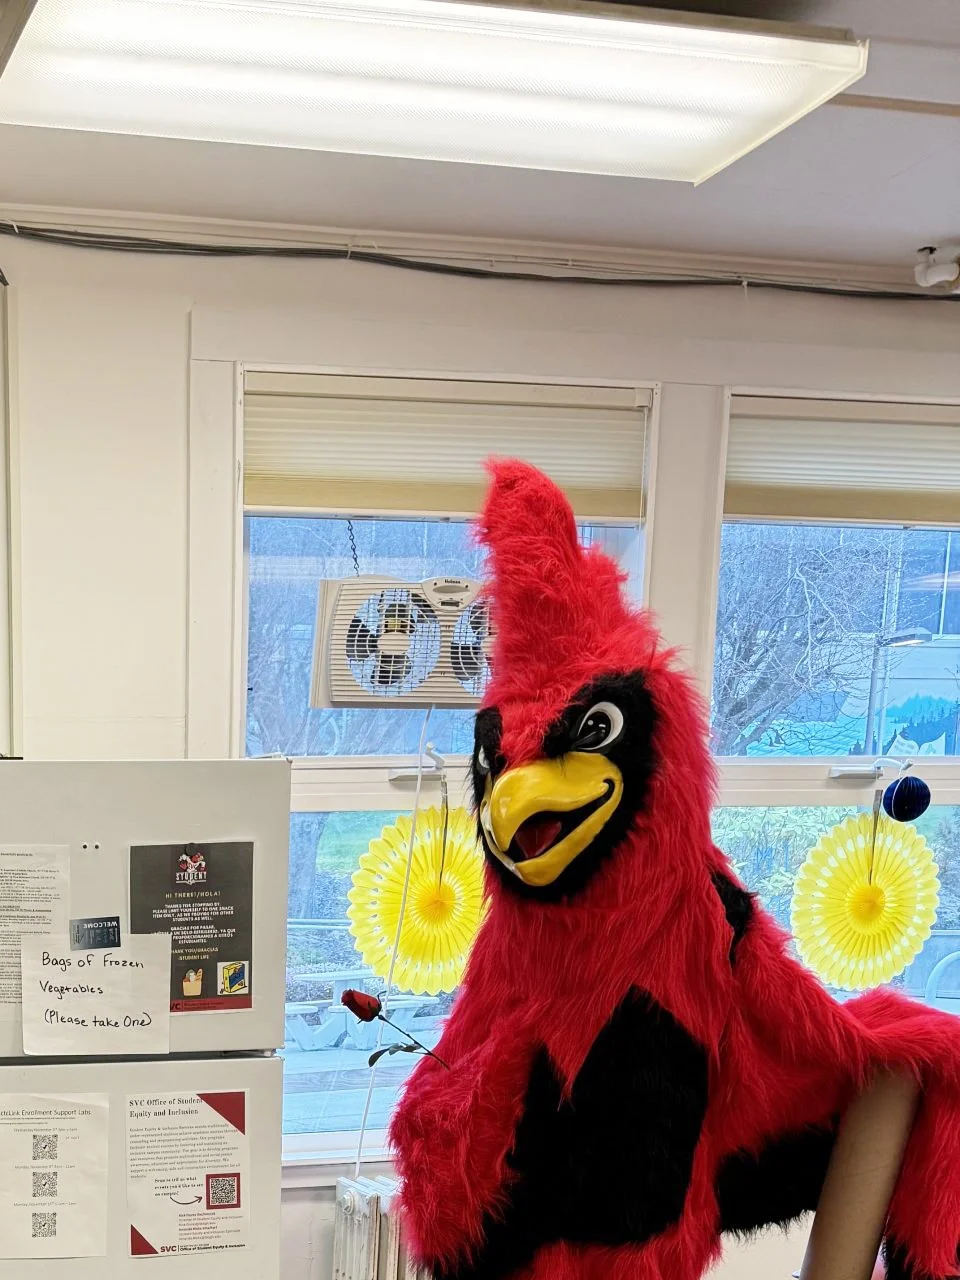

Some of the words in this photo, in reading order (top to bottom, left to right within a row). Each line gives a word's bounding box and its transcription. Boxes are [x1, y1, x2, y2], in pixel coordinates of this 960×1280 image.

[175, 871, 207, 881] STUDENT
[83, 921, 118, 929] WELCOME
[42, 952, 72, 972] Bags
[103, 953, 144, 969] Frozen
[39, 980, 104, 999] Vegetables
[44, 1008, 88, 1027] (Please
[92, 1015, 120, 1027] take
[123, 1012, 152, 1027] One)
[129, 1099, 145, 1107] SVC
[147, 1098, 167, 1106] Office
[54, 1109, 76, 1117] Support
[129, 1110, 151, 1119] Equity
[168, 1108, 199, 1116] Inclusion
[160, 1245, 177, 1253] SVC
